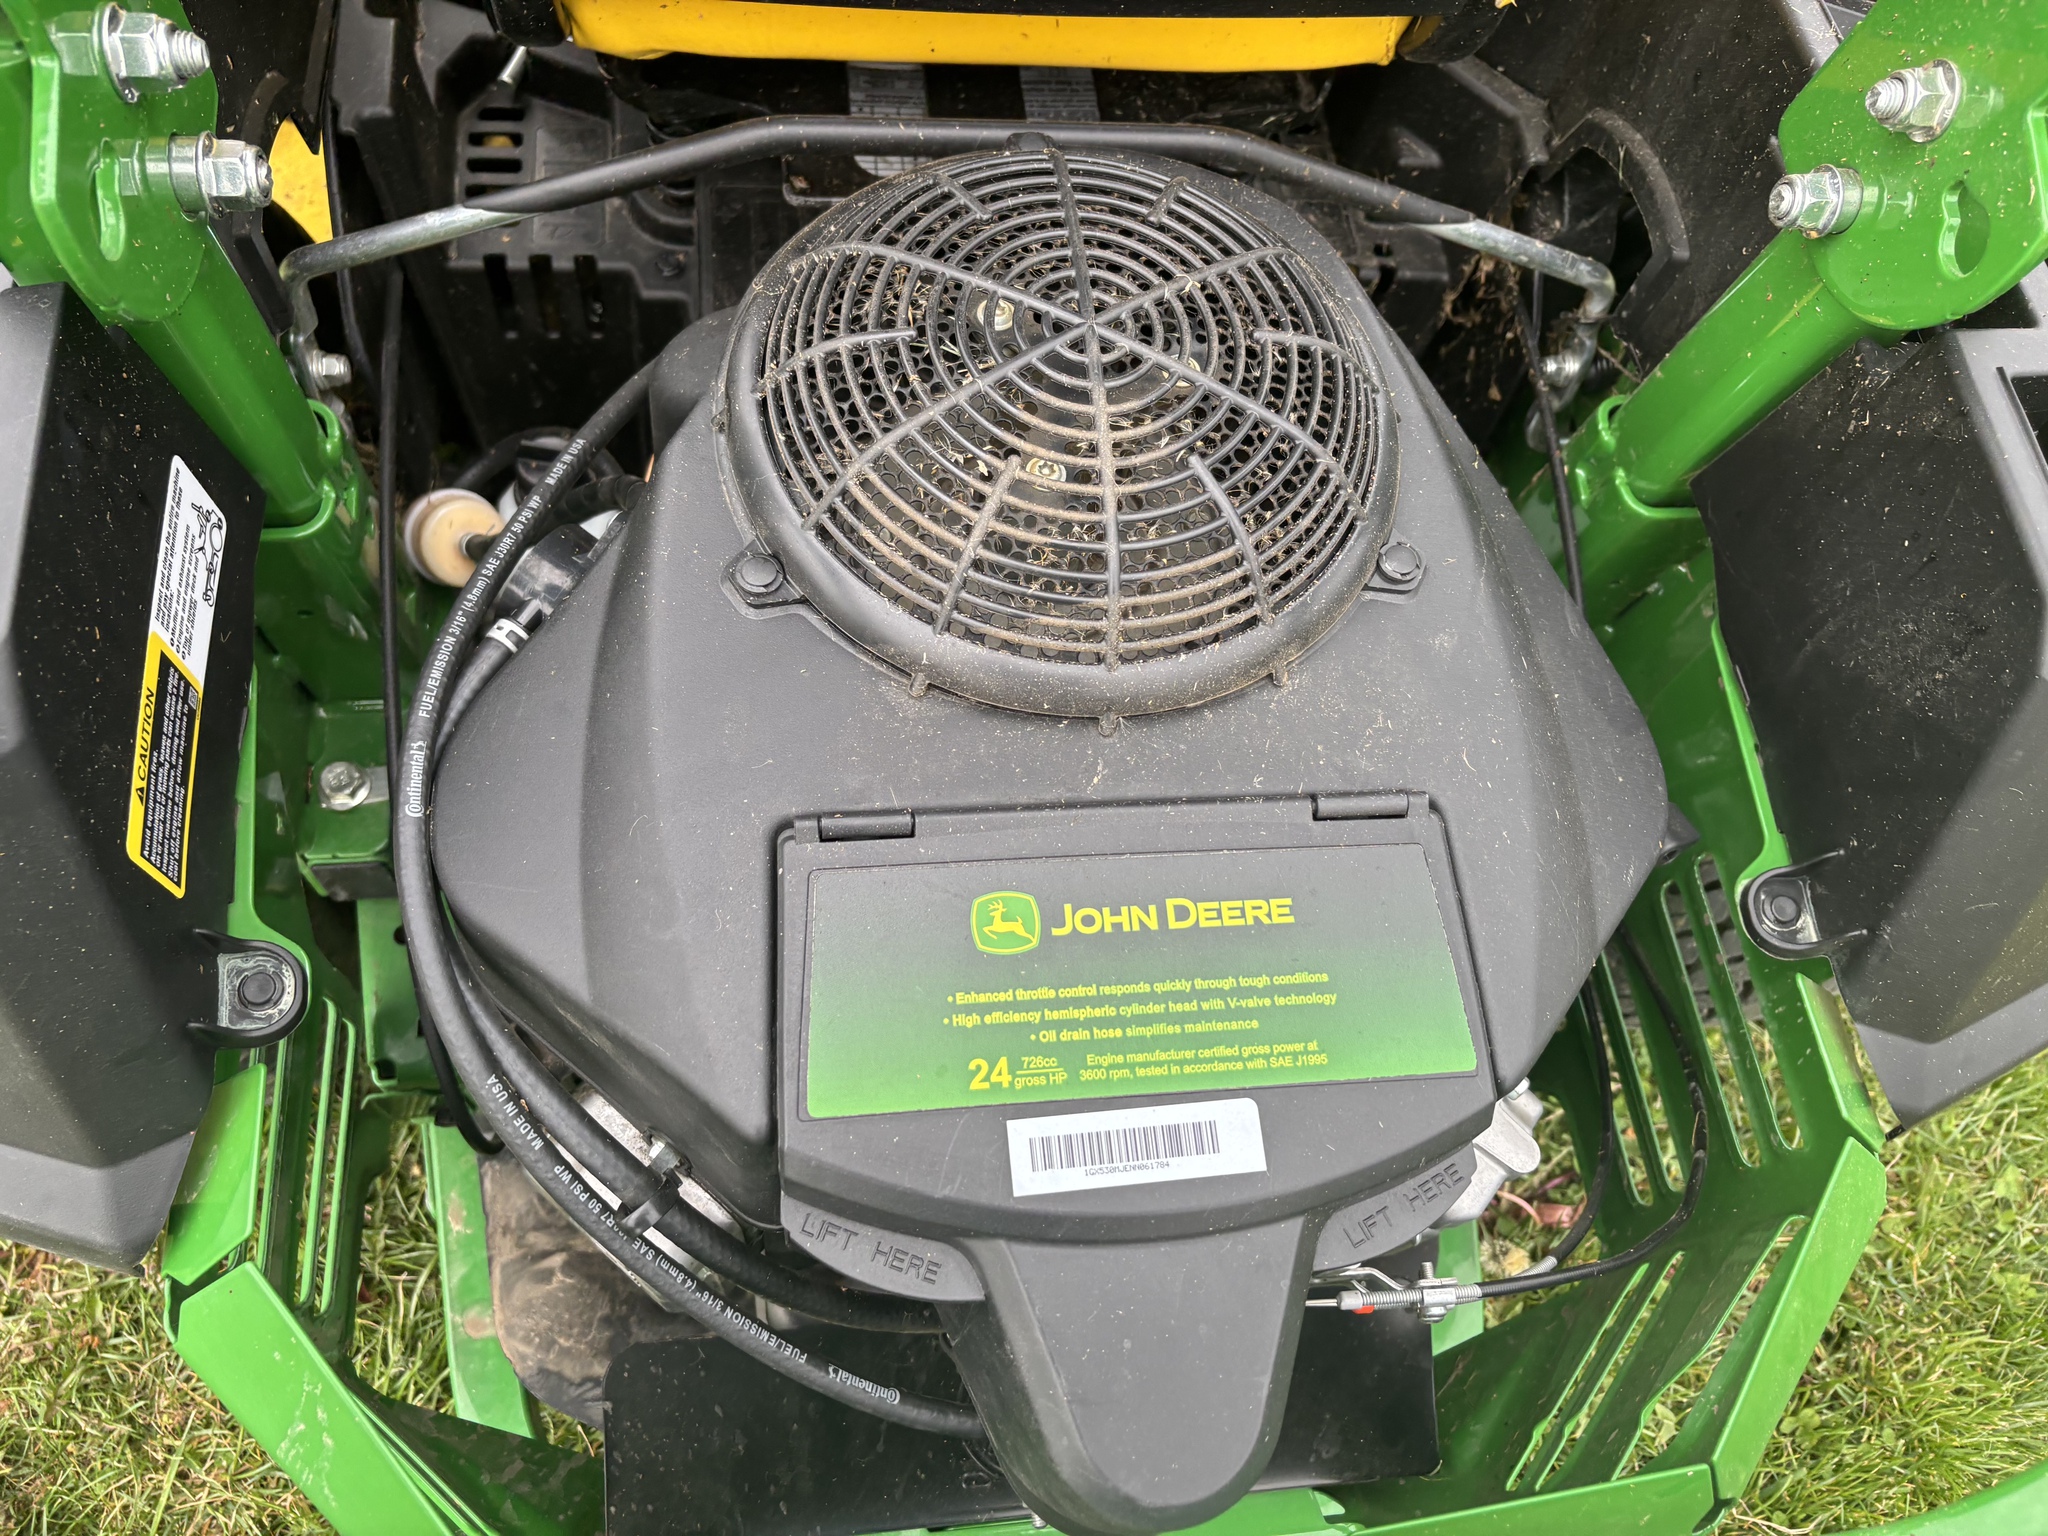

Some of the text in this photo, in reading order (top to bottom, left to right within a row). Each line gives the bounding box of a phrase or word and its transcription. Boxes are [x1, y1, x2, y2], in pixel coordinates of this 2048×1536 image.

[155, 589, 163, 622] Inspect
[172, 468, 180, 504] machine
[170, 522, 178, 559] attention
[419, 635, 456, 718] FUEL/EMISSION
[455, 611, 467, 635] 3/16"
[464, 575, 491, 612] (4.8mm)
[482, 555, 500, 576] SAE
[499, 533, 517, 559] J30R7
[511, 522, 524, 534] 50
[519, 507, 535, 524] PSI
[527, 495, 543, 510] WP
[545, 463, 564, 486] MADE
[562, 453, 573, 466] IN
[568, 438, 586, 455] USA
[138, 688, 154, 781] CAUTION
[156, 855, 161, 867] on
[161, 762, 170, 794] moving
[176, 786, 185, 827] cleaning.
[151, 804, 161, 863] Accumulation
[1051, 897, 1295, 935] JOHN DEERE
[956, 971, 1329, 1004] Enhanced throttle control responds quickly through tough conditions
[953, 992, 1337, 1028] High efficiency hemispheric cylinder head with V-valve technology
[1039, 1018, 1259, 1042] Oil drain hose simplifies maintenance
[1021, 1056, 1058, 1068] 726cc
[1080, 1053, 1328, 1080] 3600 rpm, tested in accordance with SAE J1995
[1086, 1039, 1318, 1067] Engine manufacturer certified gross power at
[968, 1056, 1012, 1090] 24
[1014, 1072, 1068, 1089] gross HP
[486, 1073, 602, 1214] 50 PSI WP MADE IN USA
[1343, 1163, 1465, 1249] LIFT HERE
[632, 1237, 655, 1260] SAE
[800, 1212, 942, 1285] LIFT HERE
[655, 1253, 697, 1293] (4.8mm)
[696, 1290, 724, 1312] 3/16"
[723, 1306, 808, 1364] FUEL/EMISSION
